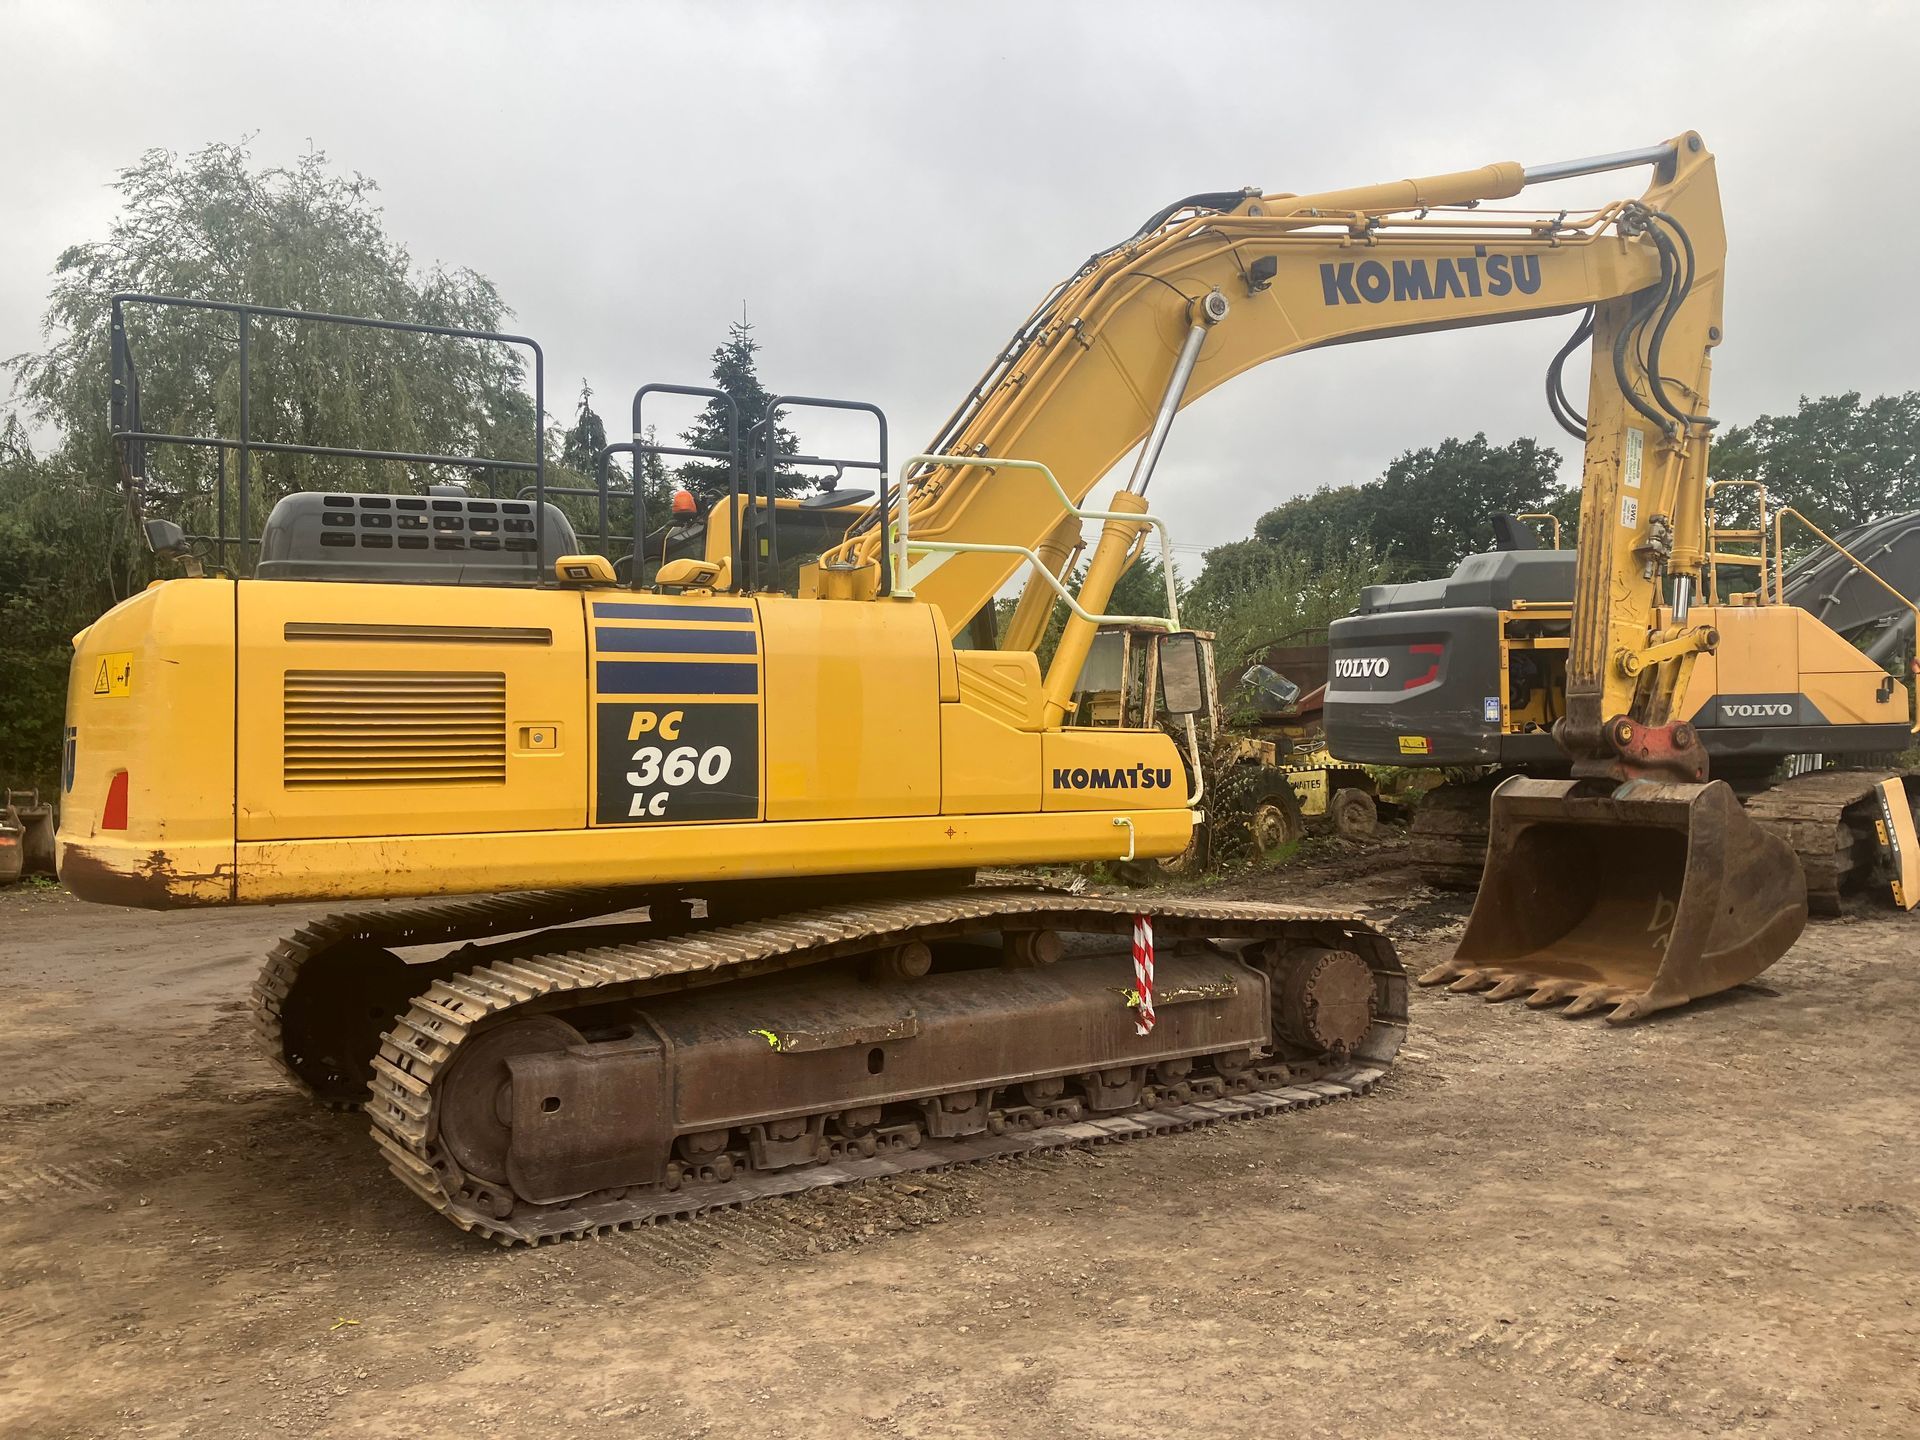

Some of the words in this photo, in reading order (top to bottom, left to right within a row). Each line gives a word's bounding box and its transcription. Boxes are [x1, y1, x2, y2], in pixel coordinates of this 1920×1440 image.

[1320, 245, 1541, 306] KOMATSU
[1335, 658, 1390, 678] VOLVO
[1721, 704, 1793, 717] VOLVO
[627, 711, 684, 741] PC
[626, 745, 732, 787] 360
[1053, 763, 1171, 789] KOMATSU
[628, 792, 670, 817] LC
